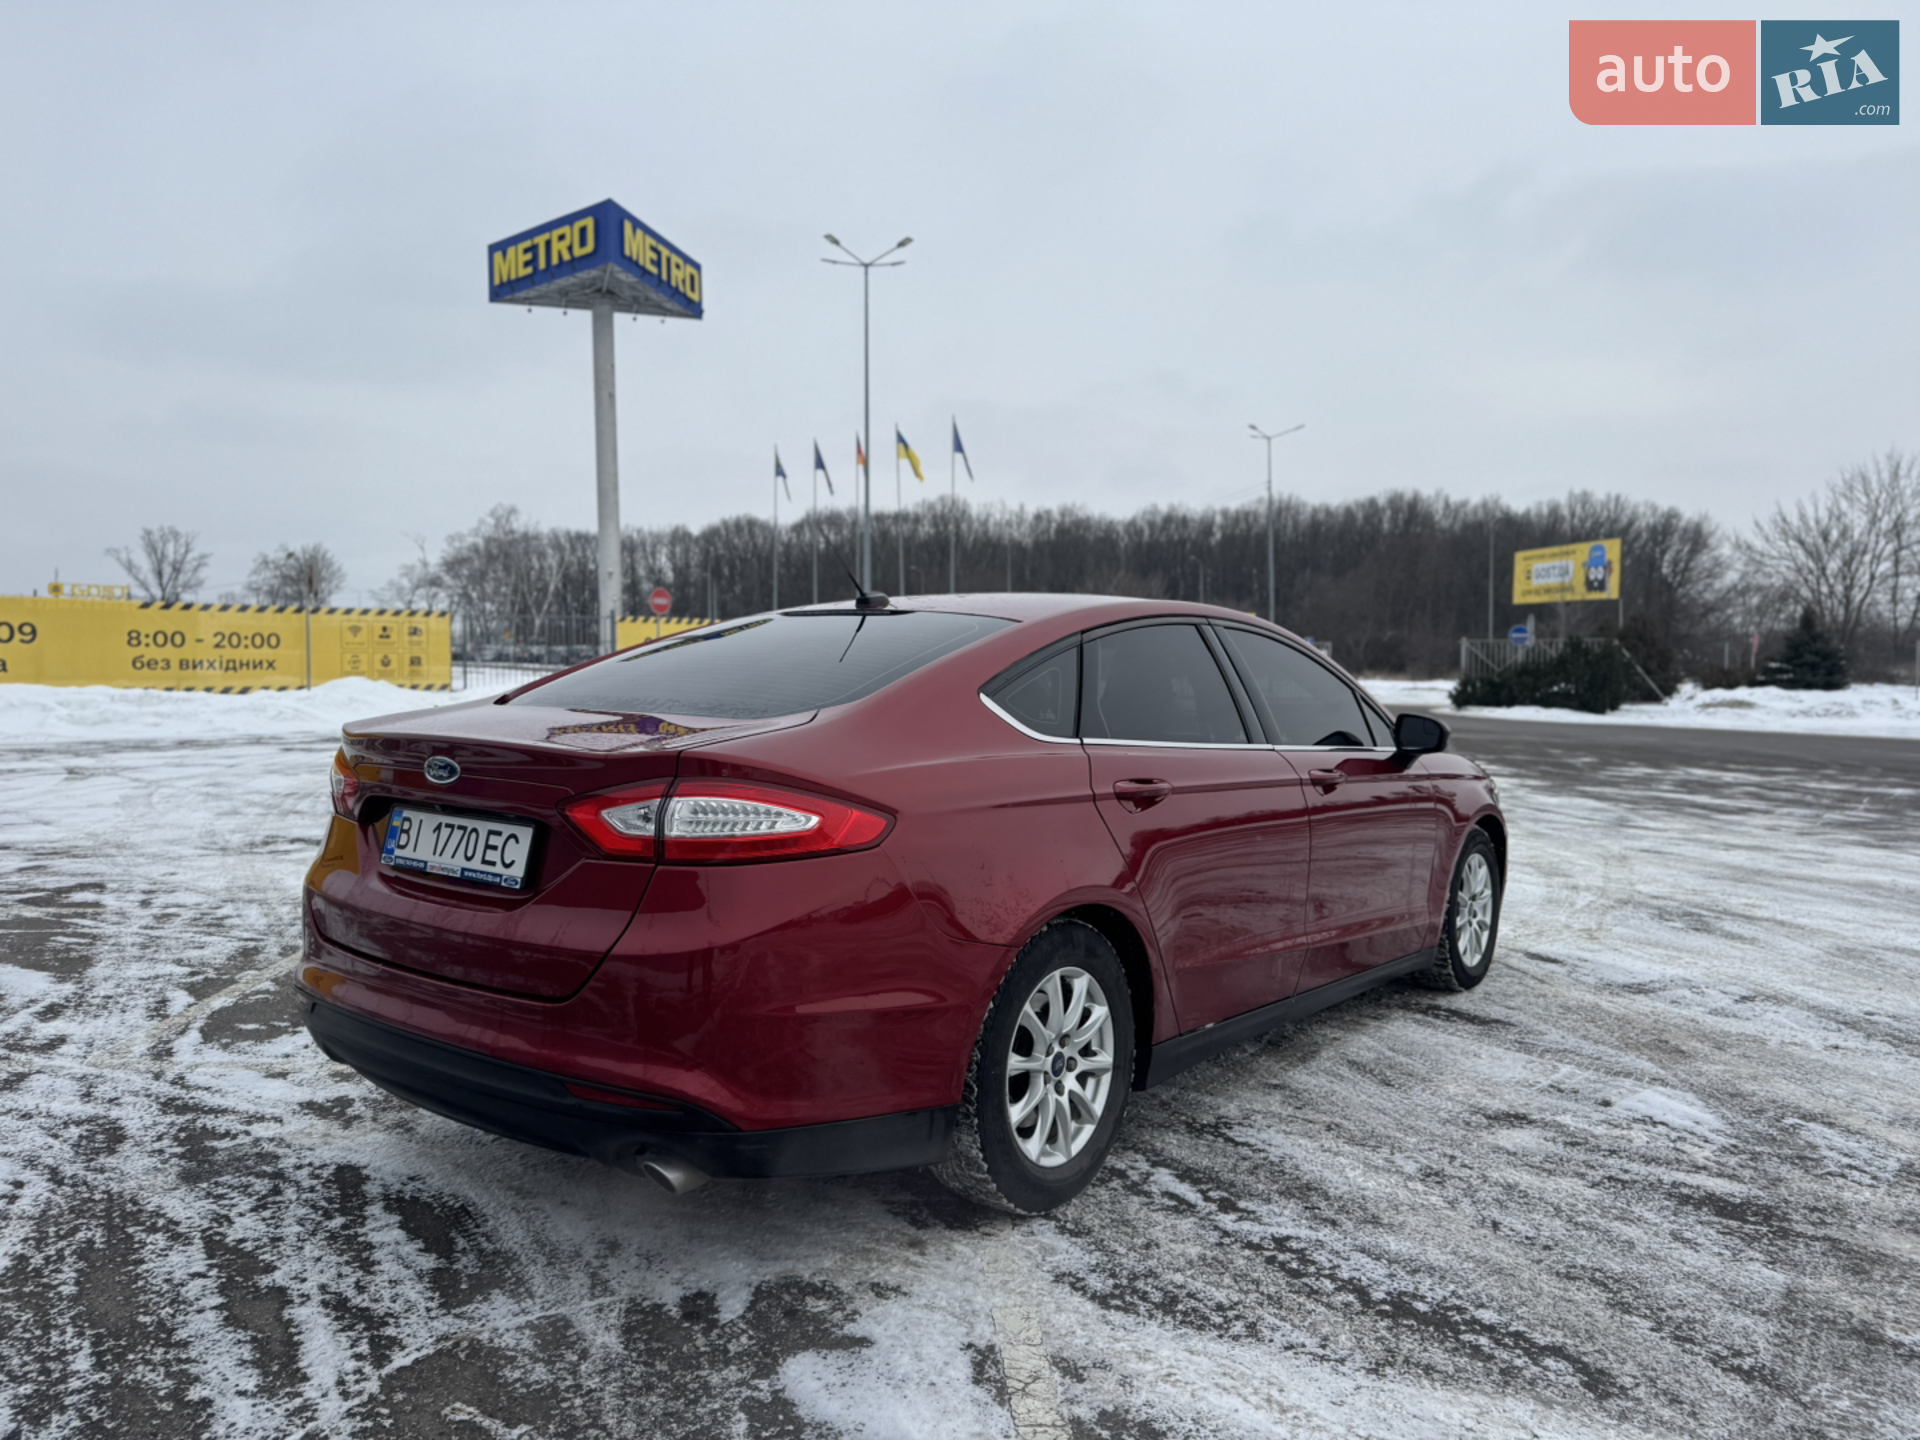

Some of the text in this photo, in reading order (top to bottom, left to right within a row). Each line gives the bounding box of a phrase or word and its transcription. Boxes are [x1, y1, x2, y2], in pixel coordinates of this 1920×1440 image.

[493, 215, 596, 287] METRO
[623, 218, 701, 303] METRO
[71, 584, 130, 598] GOST
[126, 629, 186, 648] 8:00
[212, 631, 281, 650] 20:00
[131, 654, 277, 674] без вихідних
[396, 816, 520, 869] BI 1770 EC
